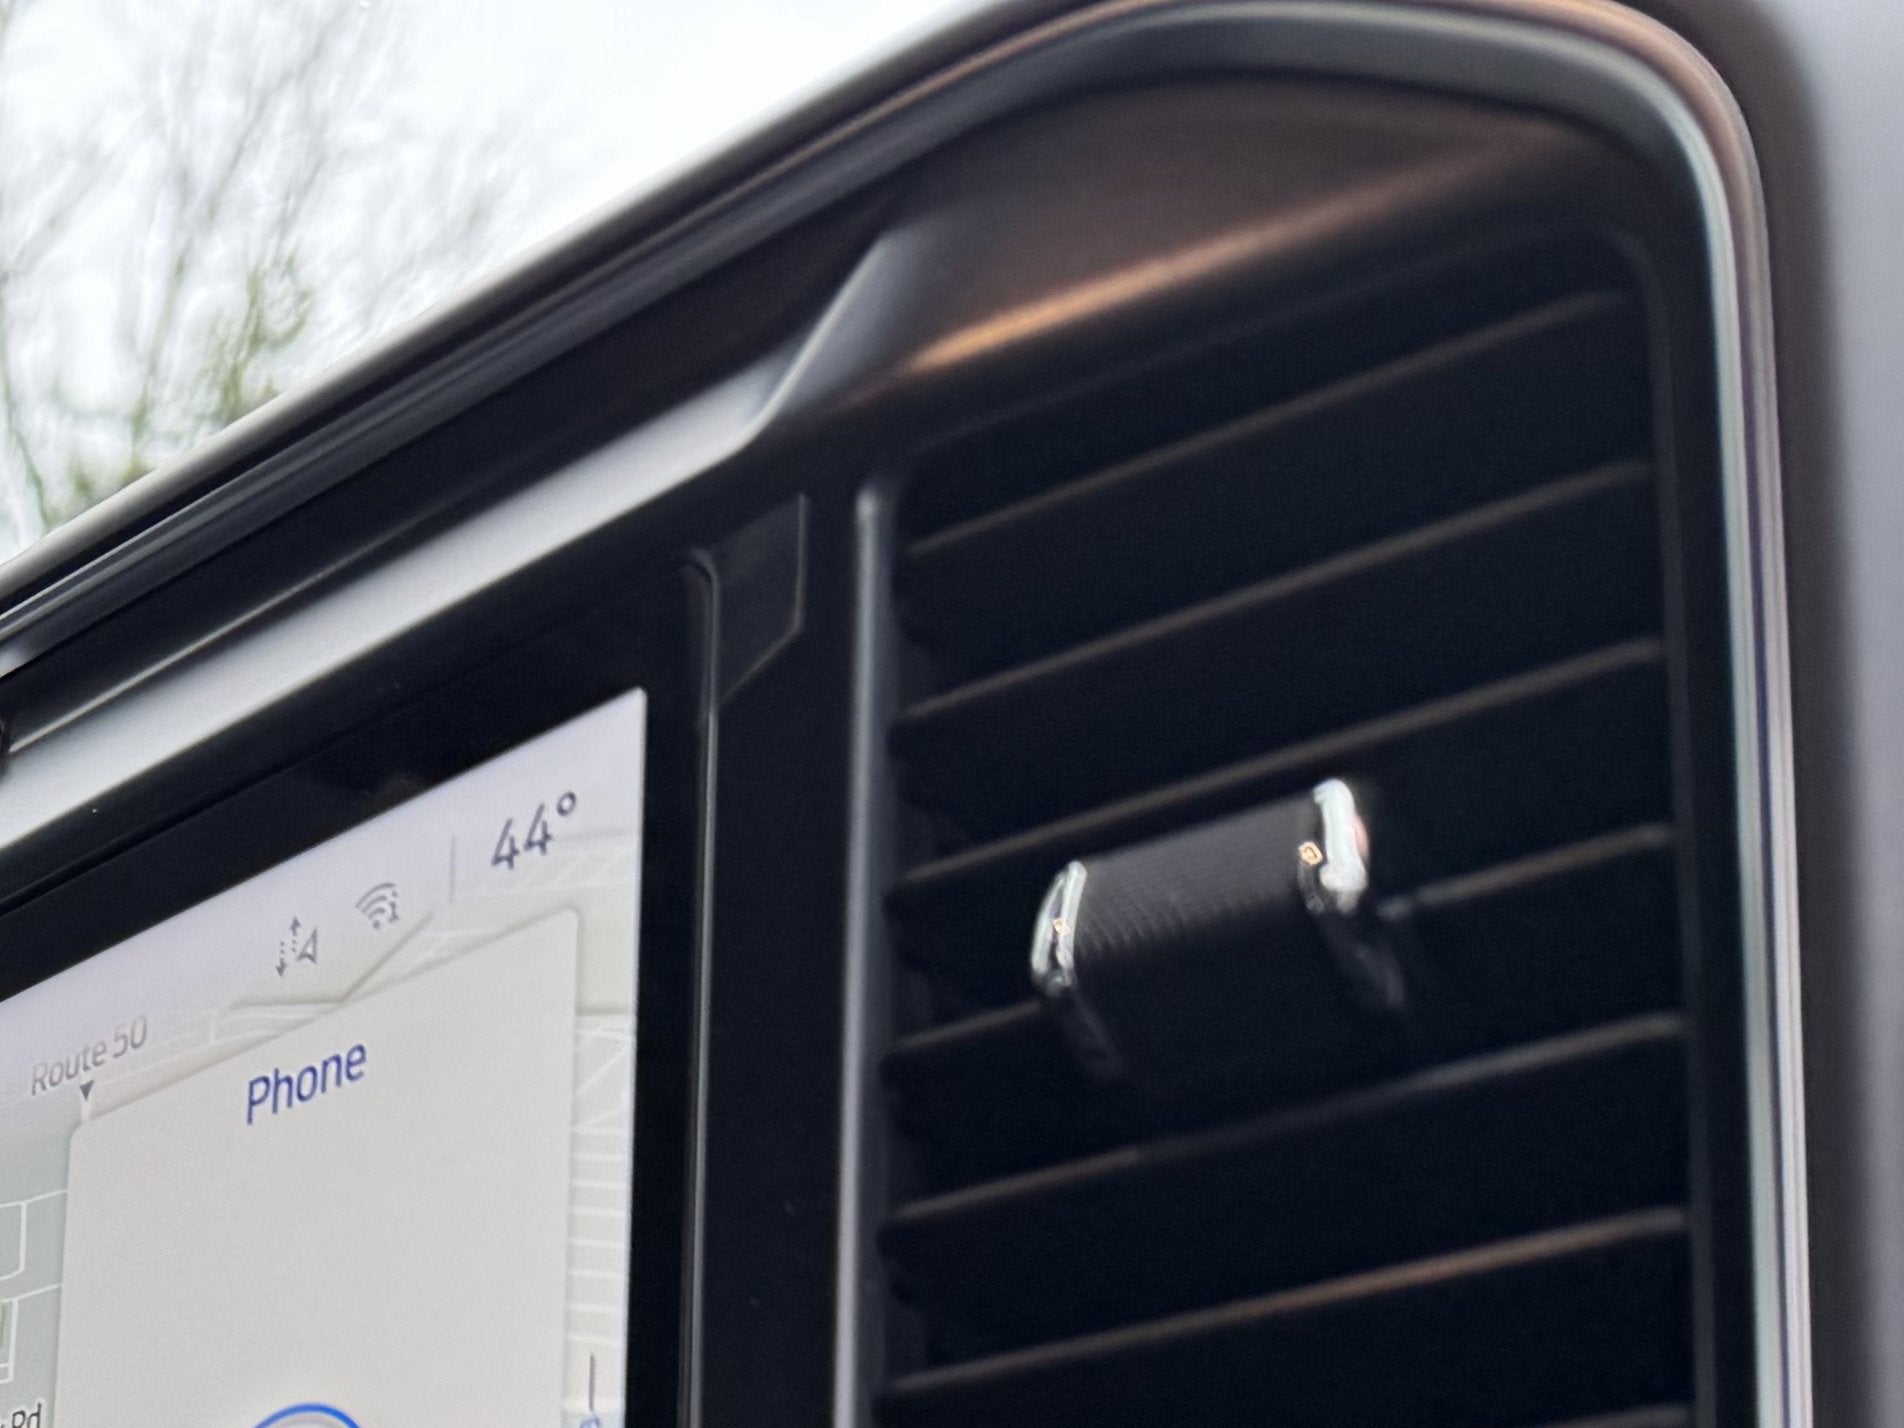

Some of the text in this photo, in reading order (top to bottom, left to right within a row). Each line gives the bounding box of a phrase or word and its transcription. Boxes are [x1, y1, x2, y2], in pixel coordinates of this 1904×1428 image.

[490, 791, 576, 870] 44°
[30, 1015, 149, 1096] Route 50
[247, 1044, 367, 1125] Phone
